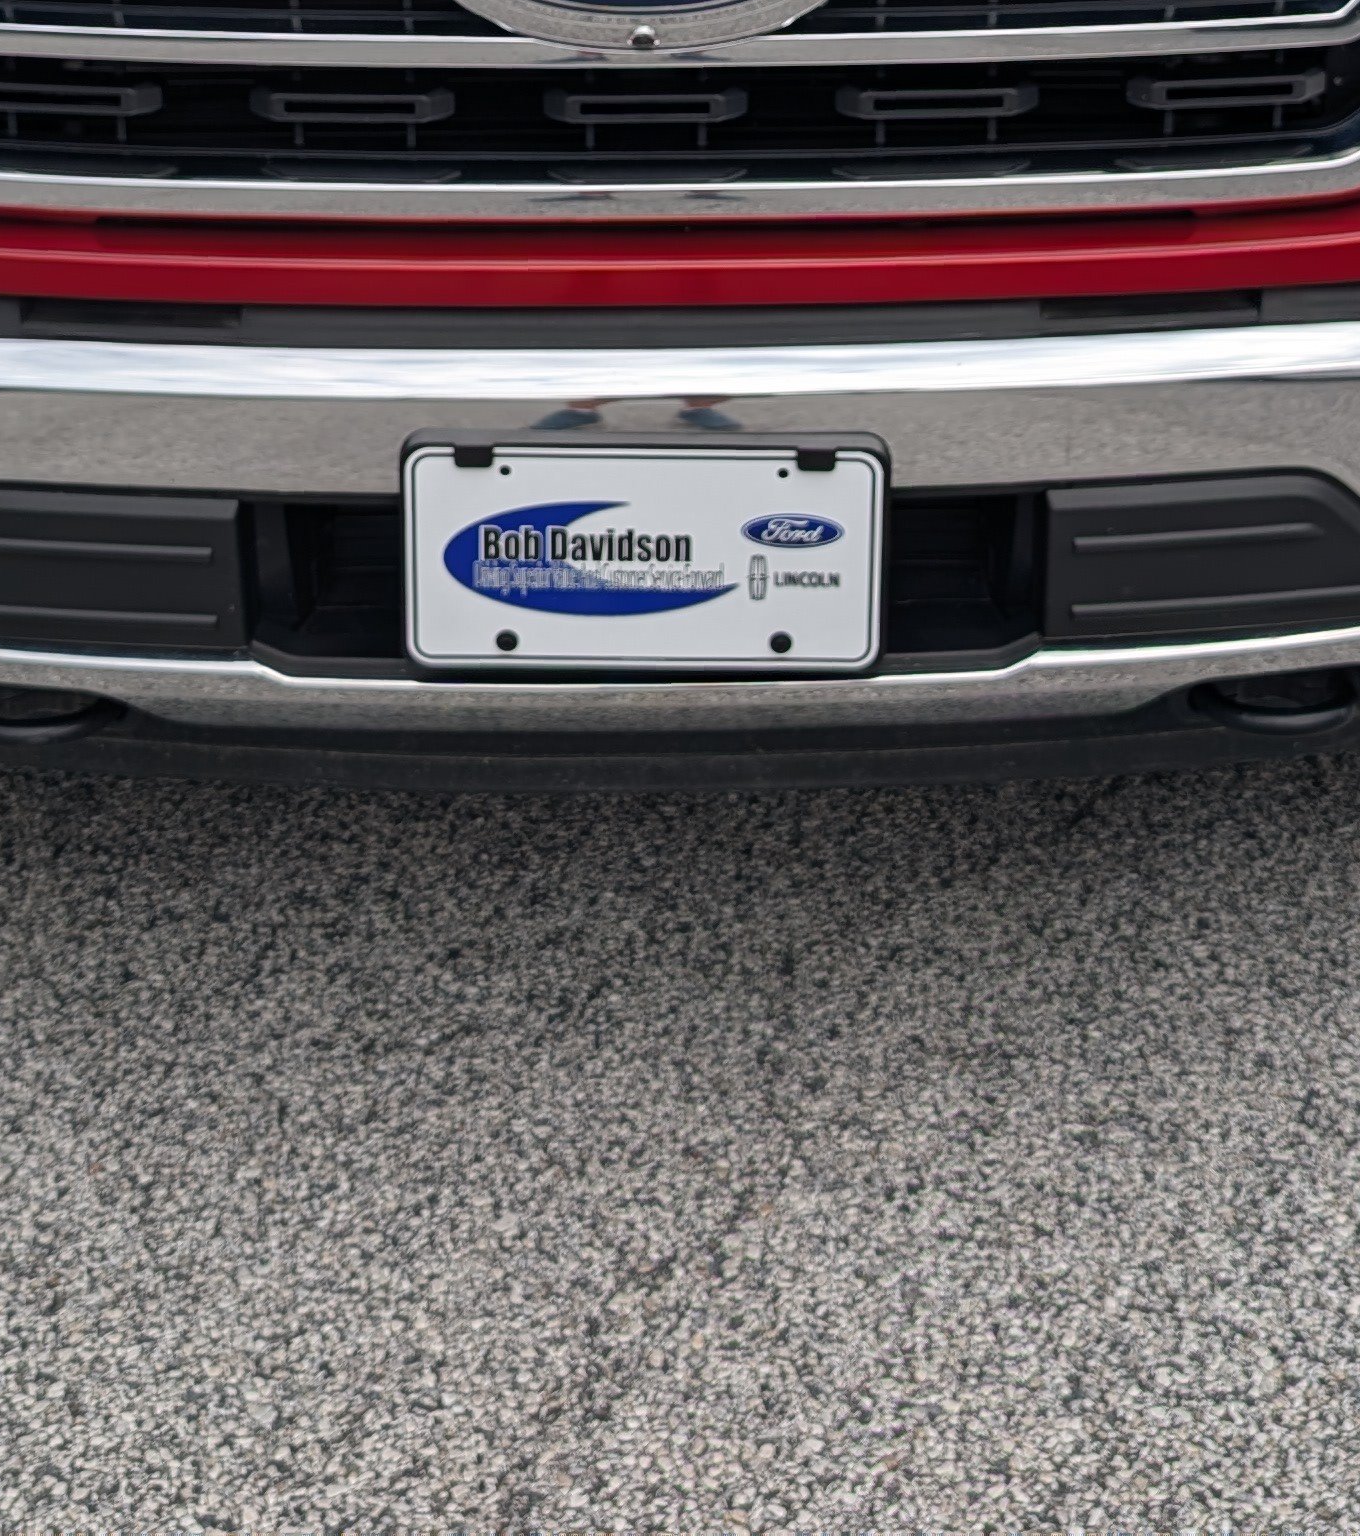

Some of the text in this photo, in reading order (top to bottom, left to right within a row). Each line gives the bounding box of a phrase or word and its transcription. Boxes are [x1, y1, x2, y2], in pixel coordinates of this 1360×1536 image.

[761, 518, 825, 542] Ford
[481, 526, 693, 563] Bob Davidson
[772, 570, 840, 587] LINCOLN
